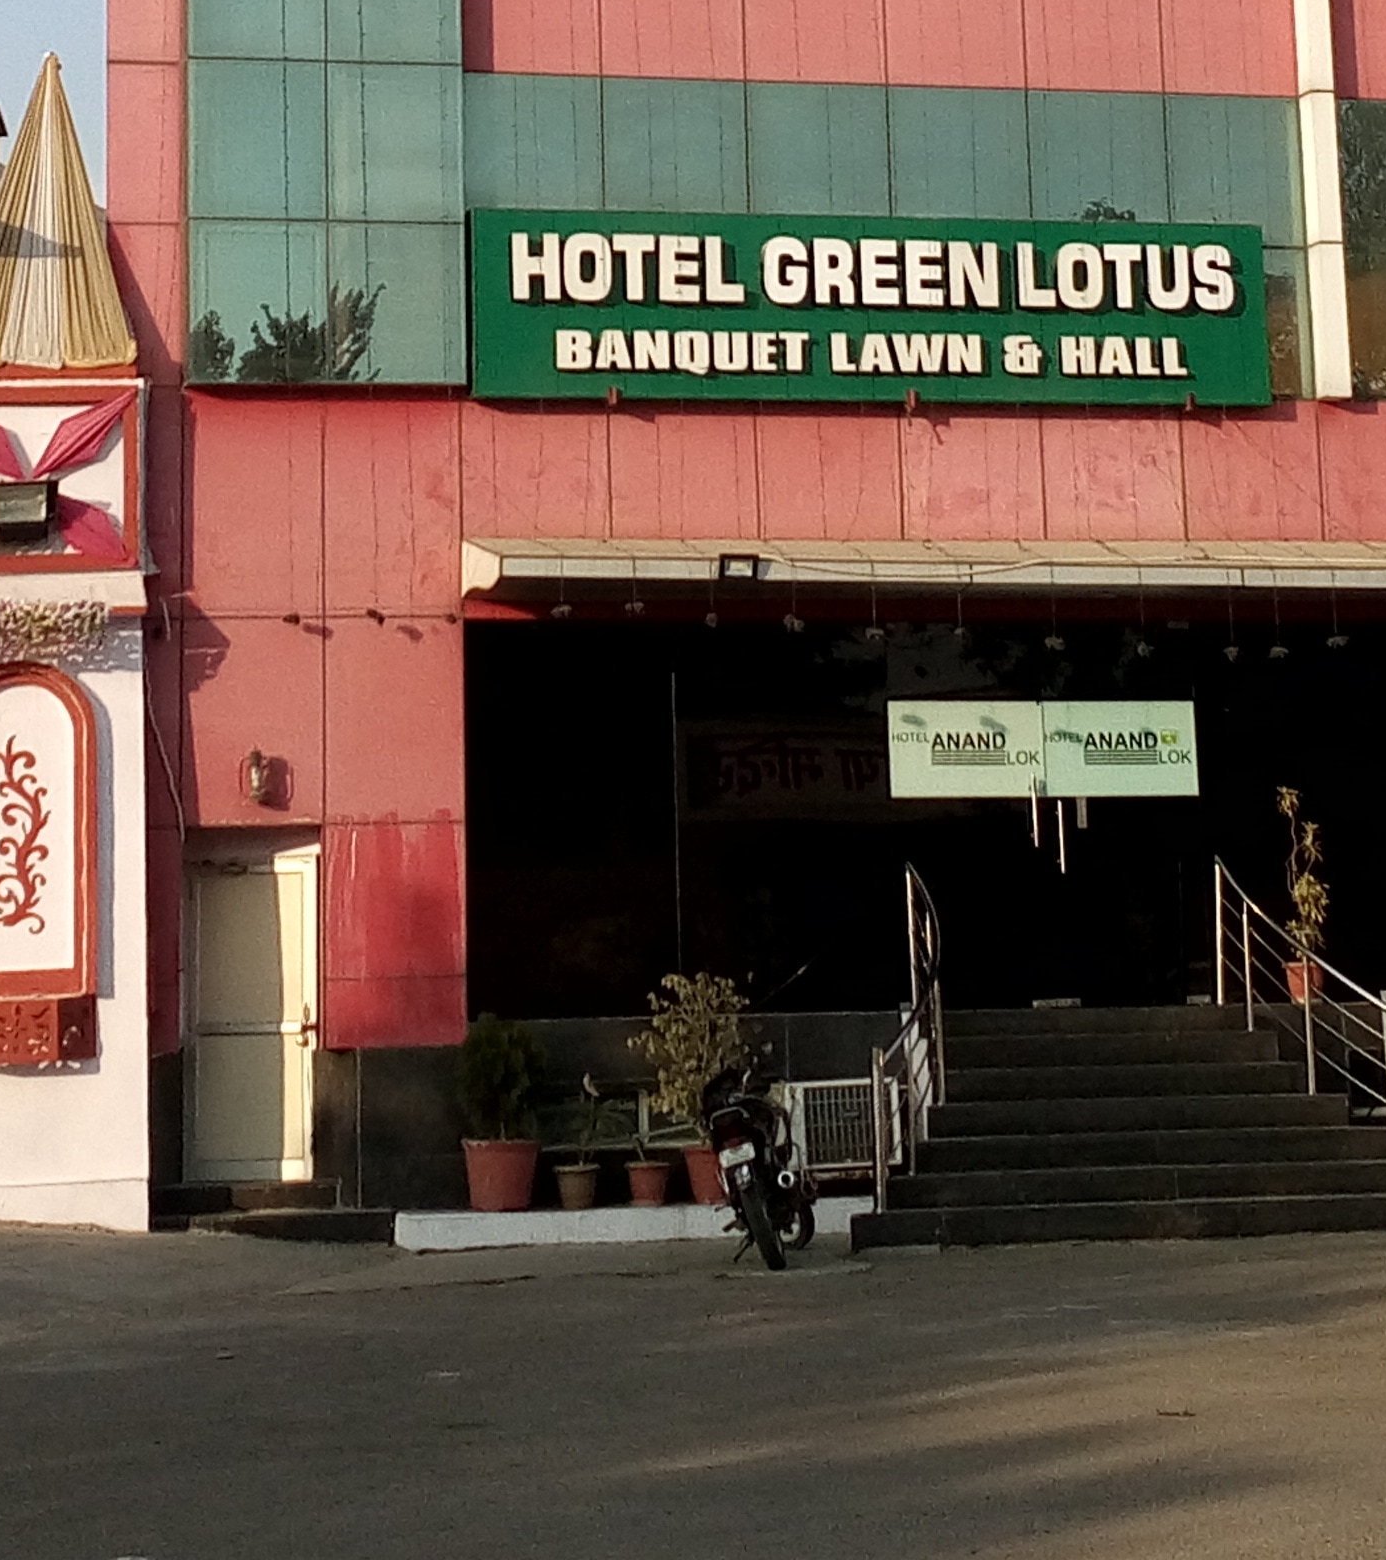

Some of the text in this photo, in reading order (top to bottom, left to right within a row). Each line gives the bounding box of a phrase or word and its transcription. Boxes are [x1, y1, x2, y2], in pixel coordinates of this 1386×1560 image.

[510, 232, 1235, 312] HOTEL GREEN LOTUS
[555, 328, 1188, 377] BANQUET LAWN & HALL
[891, 732, 1006, 750] HOTEL ANAND
[1084, 732, 1158, 750] ANAND
[1007, 750, 1040, 765] LOK
[1158, 750, 1192, 765] LOK
